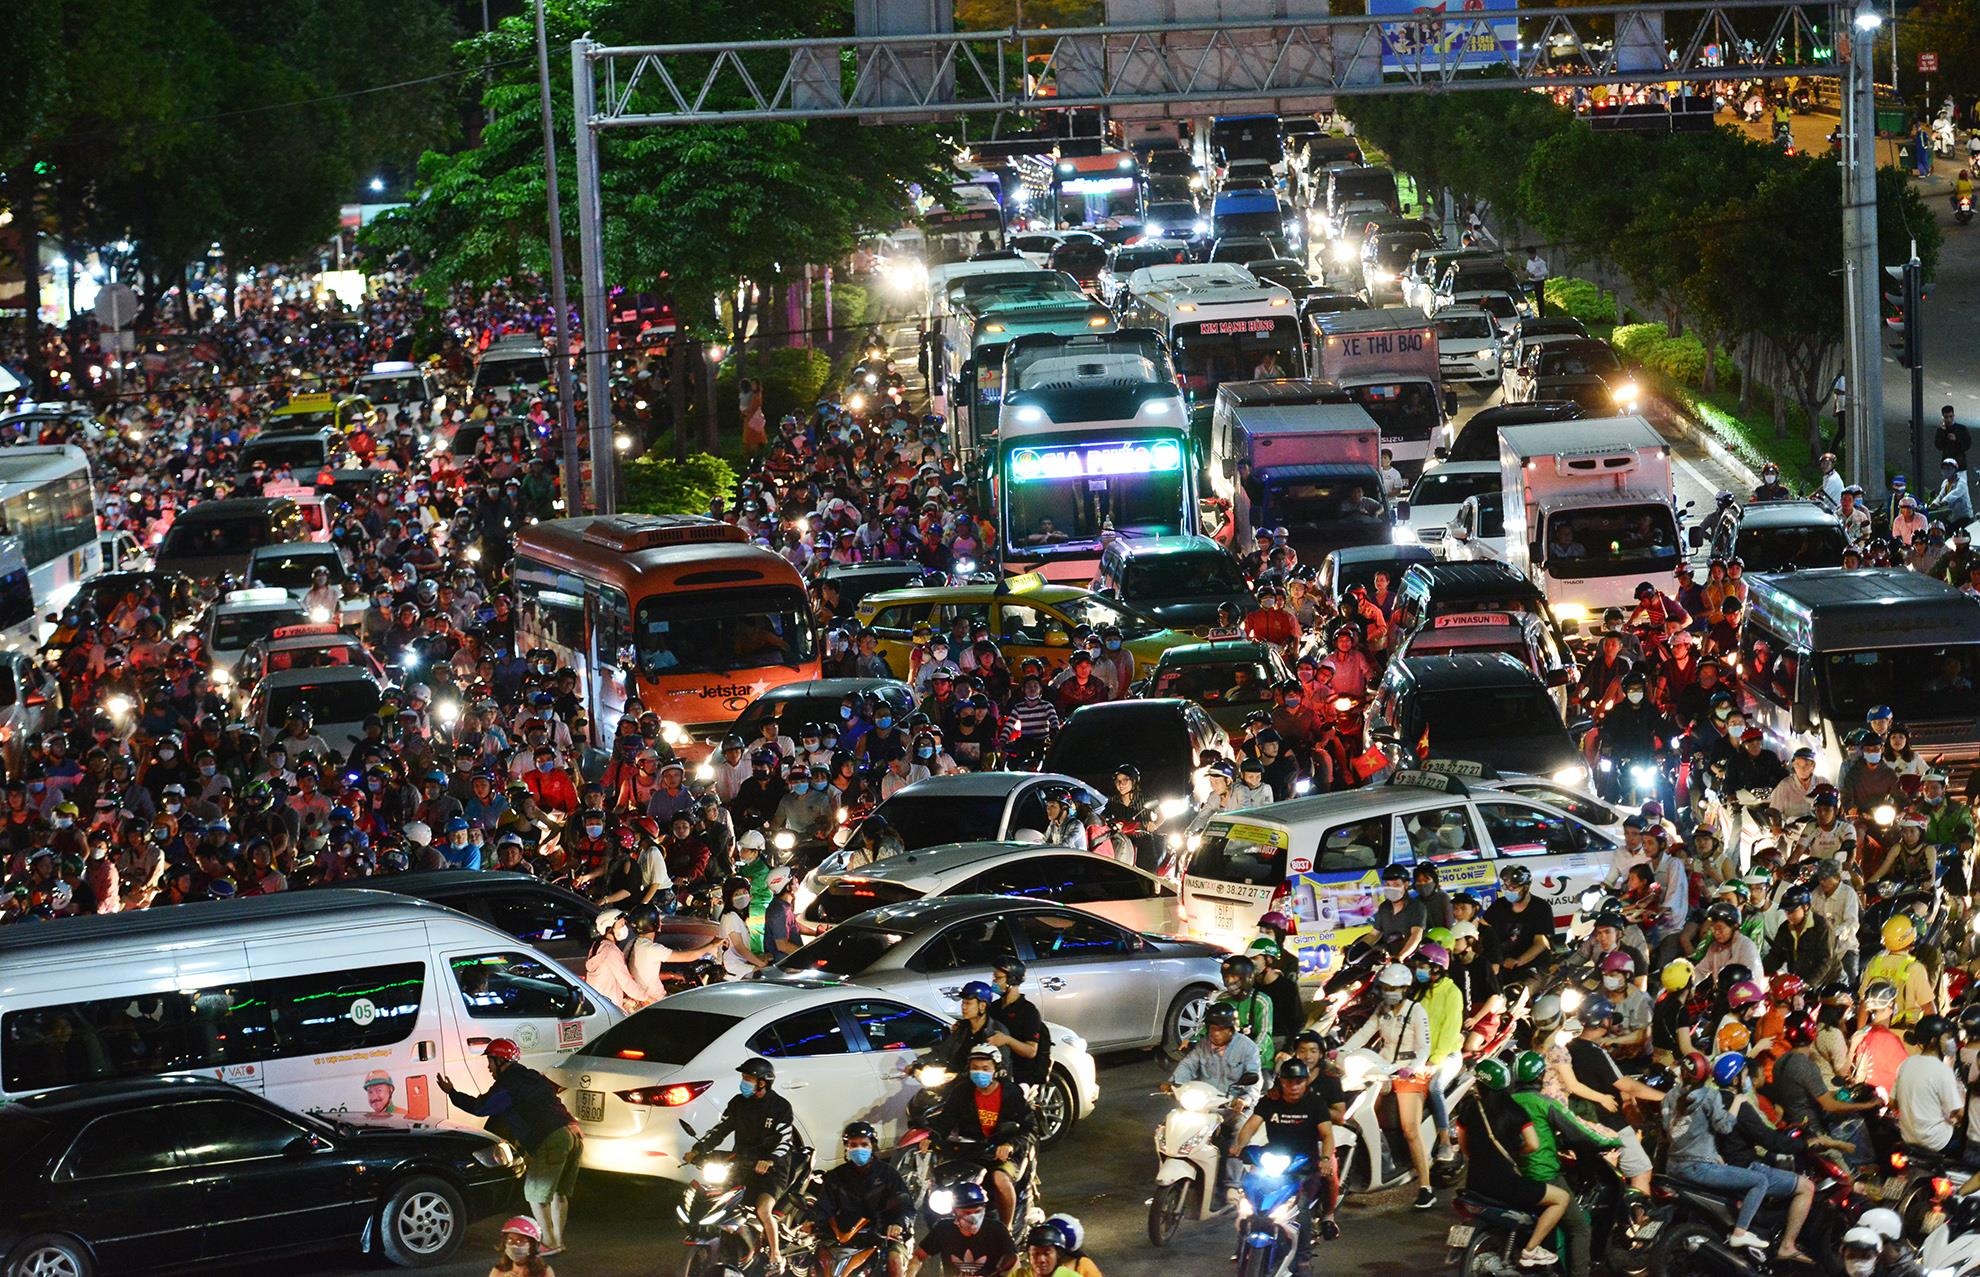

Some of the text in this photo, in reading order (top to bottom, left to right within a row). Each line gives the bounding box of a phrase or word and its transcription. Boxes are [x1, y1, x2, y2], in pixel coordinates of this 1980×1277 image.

[1200, 323, 1219, 335] KIM
[1342, 338, 1361, 356] XE
[1453, 616, 1490, 624] VINASUN
[699, 684, 752, 698] Jetstar
[1291, 860, 1309, 871] 8037
[1226, 884, 1247, 896] 38.27
[1248, 887, 1259, 898] 27
[1260, 889, 1271, 899] 27
[355, 1004, 372, 1019] 05
[582, 1092, 597, 1106] 51F
